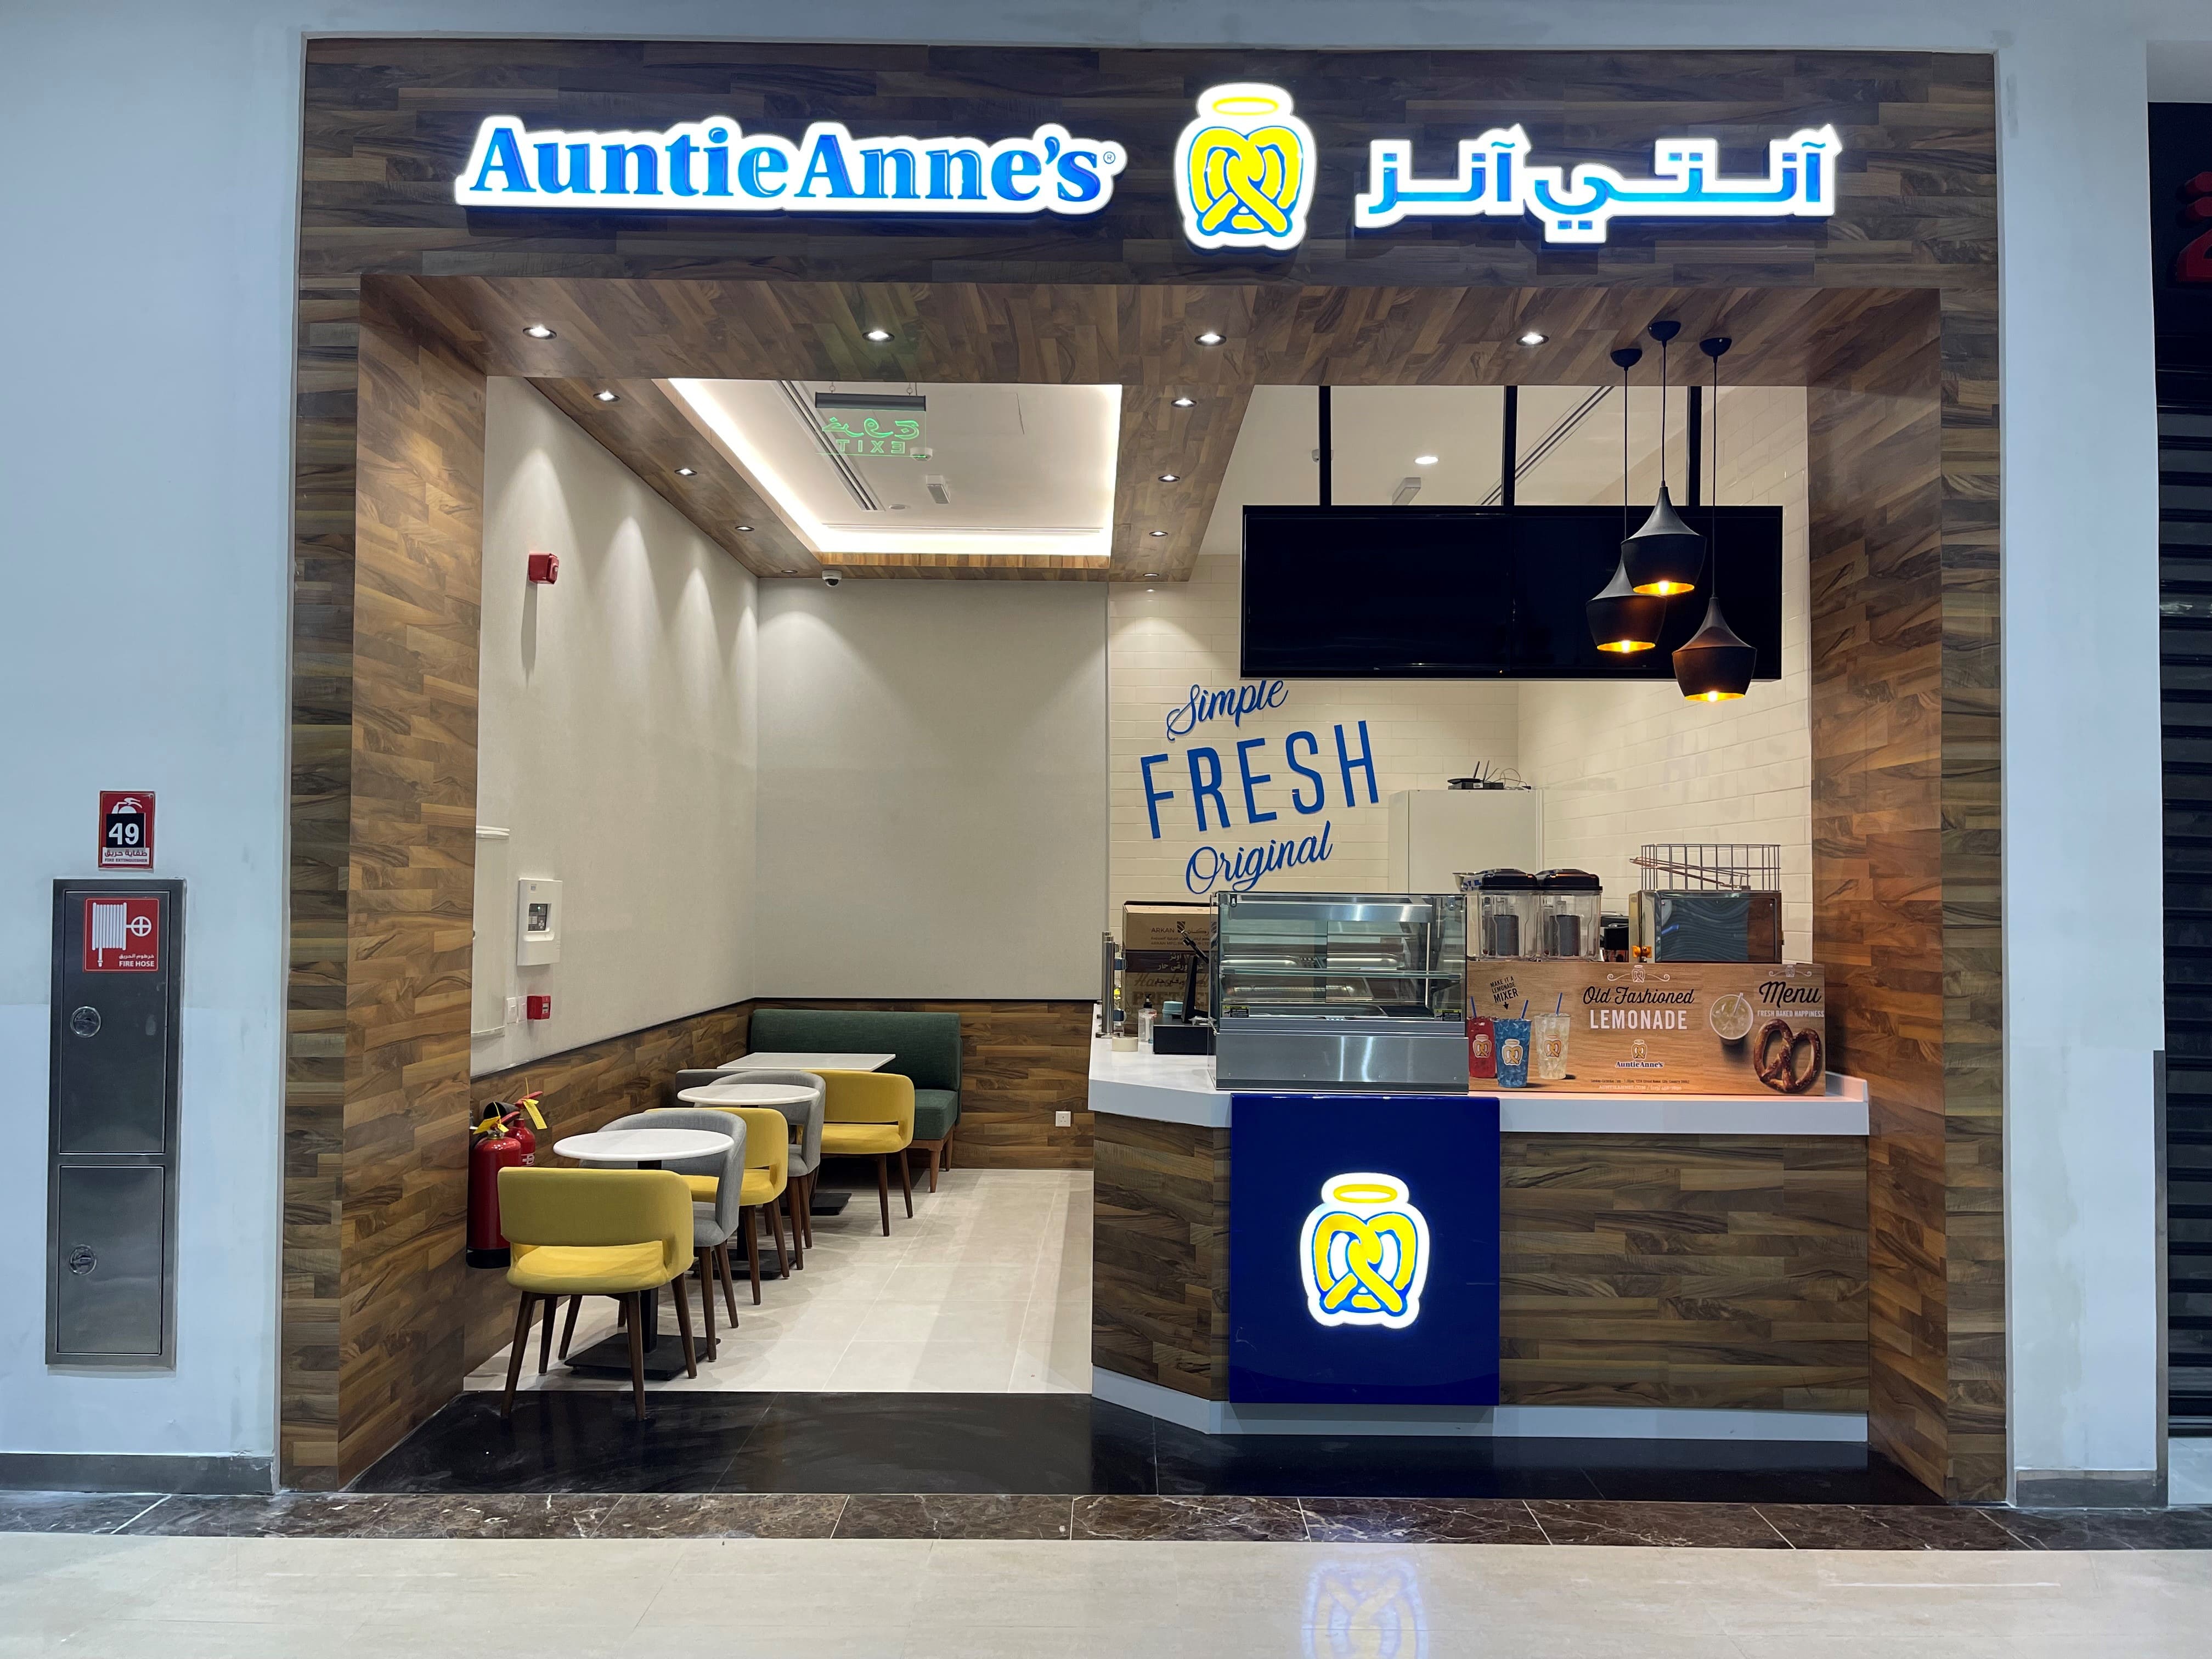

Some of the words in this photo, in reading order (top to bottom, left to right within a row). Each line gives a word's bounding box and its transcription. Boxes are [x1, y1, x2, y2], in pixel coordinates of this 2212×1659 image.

[1368, 141, 1516, 215] آنز
[1536, 141, 1826, 230] آنتي
[1166, 679, 1289, 742] Simple
[1140, 720, 1379, 839] FRESH
[109, 822, 139, 845] 49
[104, 849, 123, 857] حريق
[125, 849, 148, 857] طفاية
[1186, 820, 1333, 895] Original
[1490, 979, 1504, 988] MAKE
[1491, 981, 1516, 994] LEMONADE
[1758, 981, 1822, 1008] Menu
[1493, 988, 1519, 1003] MIXER
[1583, 986, 1612, 1005] Old
[1615, 986, 1695, 1005] Fashioned
[1590, 1009, 1688, 1030] LEMONADE
